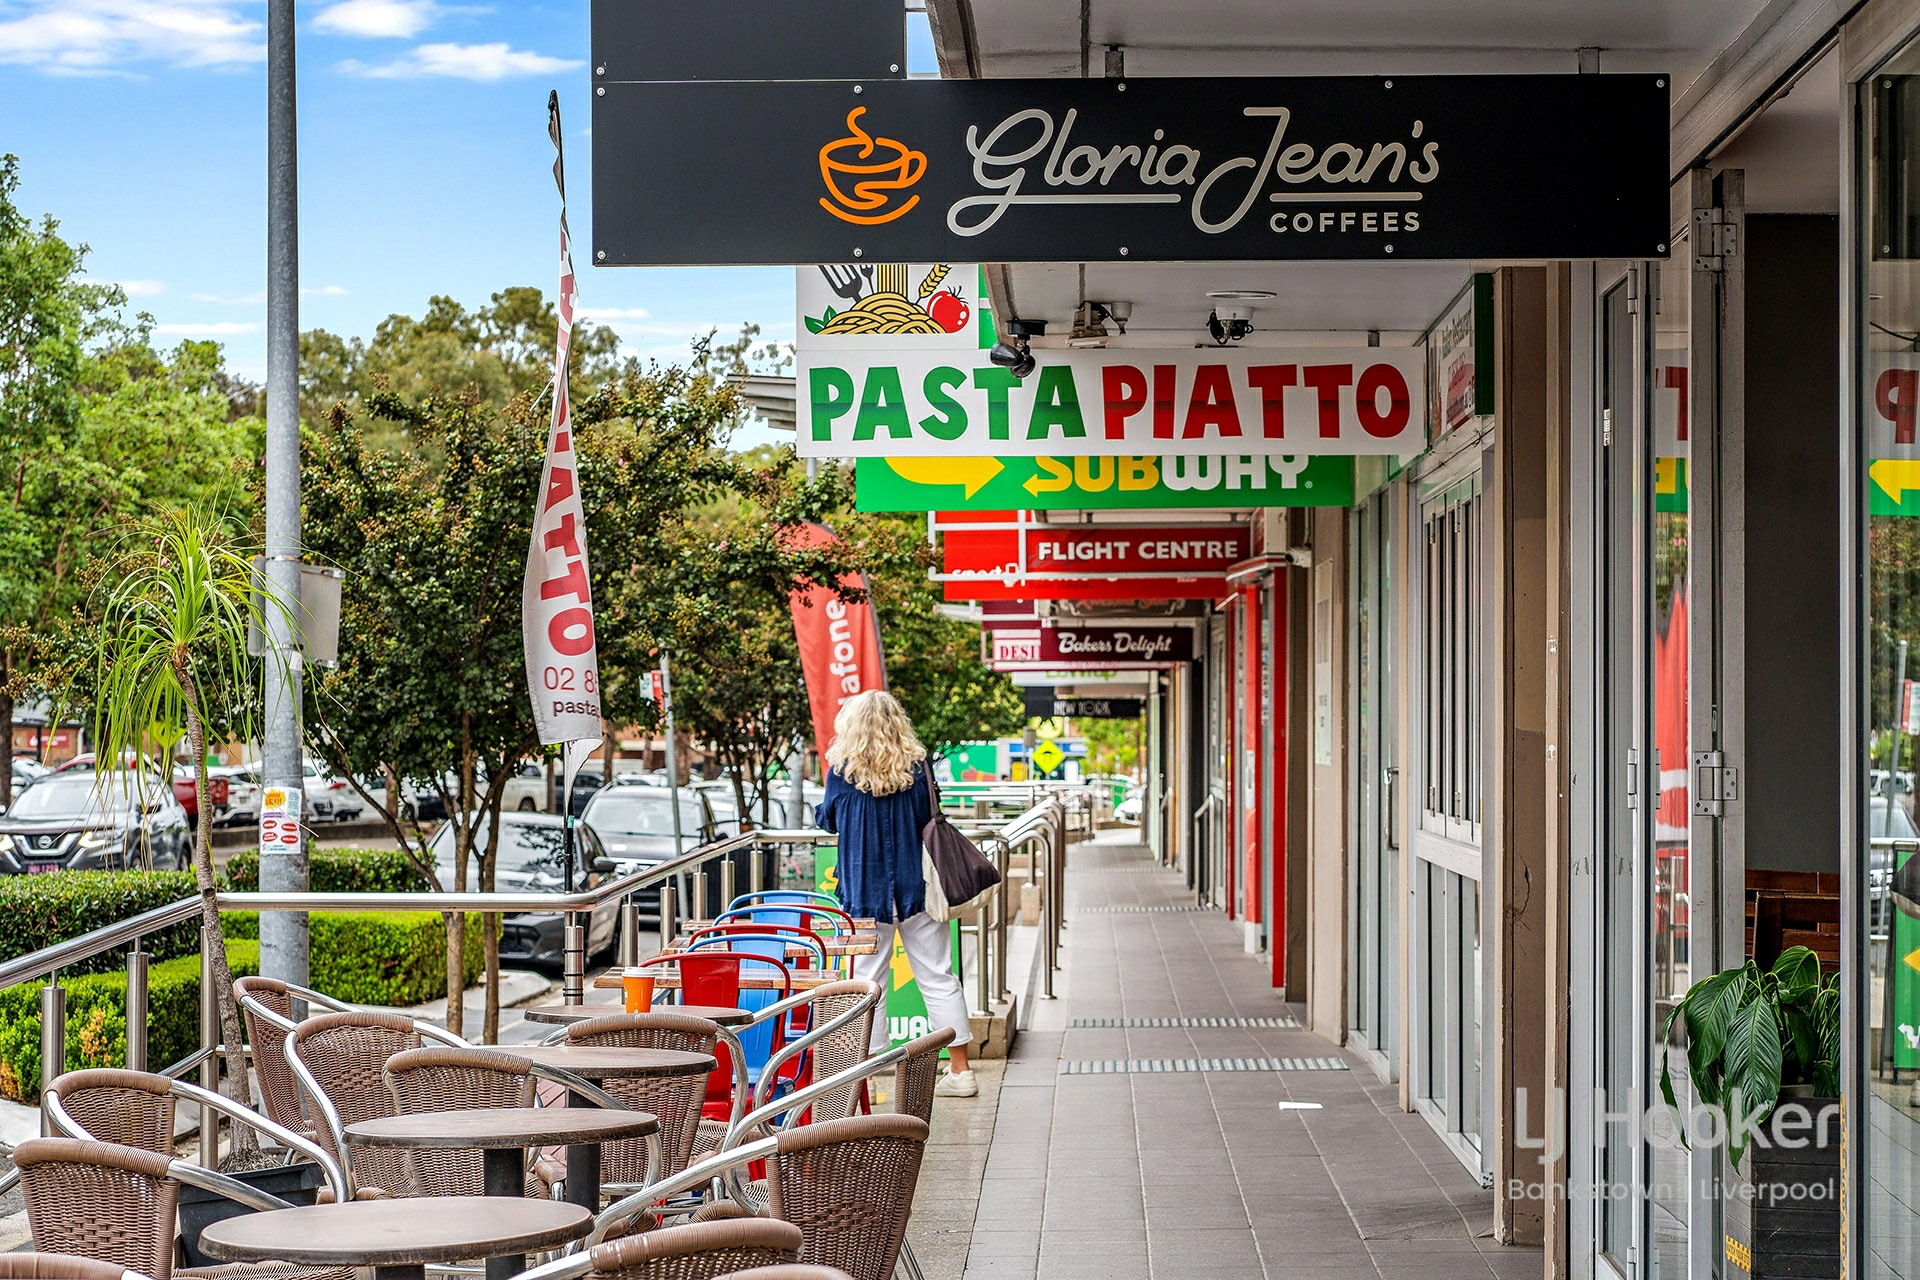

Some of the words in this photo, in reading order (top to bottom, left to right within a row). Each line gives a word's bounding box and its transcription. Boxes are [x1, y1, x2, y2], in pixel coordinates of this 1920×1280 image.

[947, 107, 1199, 237] Gloria
[1191, 106, 1439, 234] Jean's
[1269, 212, 1421, 233] COFFEES
[808, 363, 1087, 443] PASTA
[1101, 362, 1411, 440] PIATTO
[1022, 455, 1309, 498] SUBWAY
[1037, 541, 1131, 561] FLIGHT
[1137, 540, 1239, 560] CENTRE
[999, 644, 1036, 659] DESI
[1057, 632, 1113, 654] Bakers
[1113, 632, 1172, 660] Delight
[543, 666, 576, 692] 02
[1053, 700, 1077, 716] NEW
[1078, 700, 1112, 716] YORK
